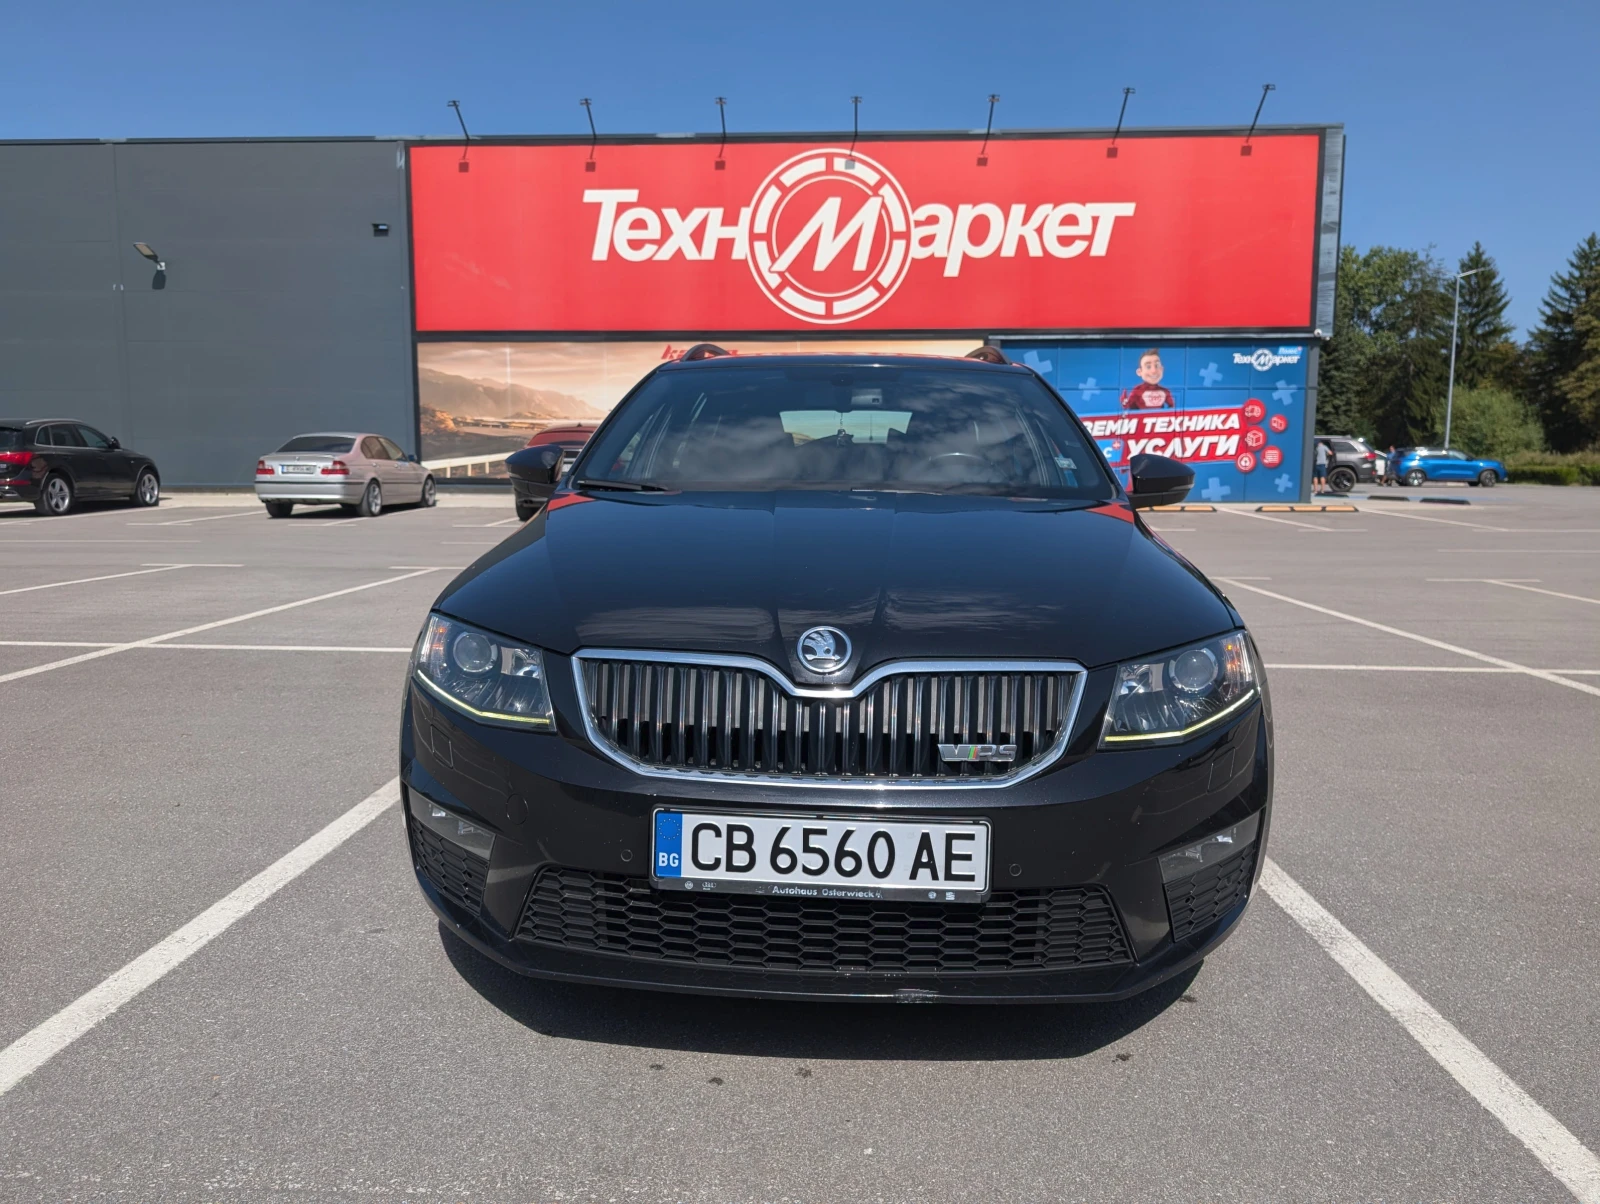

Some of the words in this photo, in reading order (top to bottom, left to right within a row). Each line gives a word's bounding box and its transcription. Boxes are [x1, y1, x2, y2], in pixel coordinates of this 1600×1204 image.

[1083, 418, 1138, 436] ЗЕМИ
[1143, 413, 1240, 434] ТЕХНИКА
[1127, 435, 1240, 459] УСЛУГИ
[658, 853, 680, 868] BG
[691, 822, 757, 873] CB
[769, 826, 896, 879] 6560
[909, 832, 976, 882] AE
[772, 886, 818, 896] Autohaus
[822, 888, 875, 898] Osterwieck
